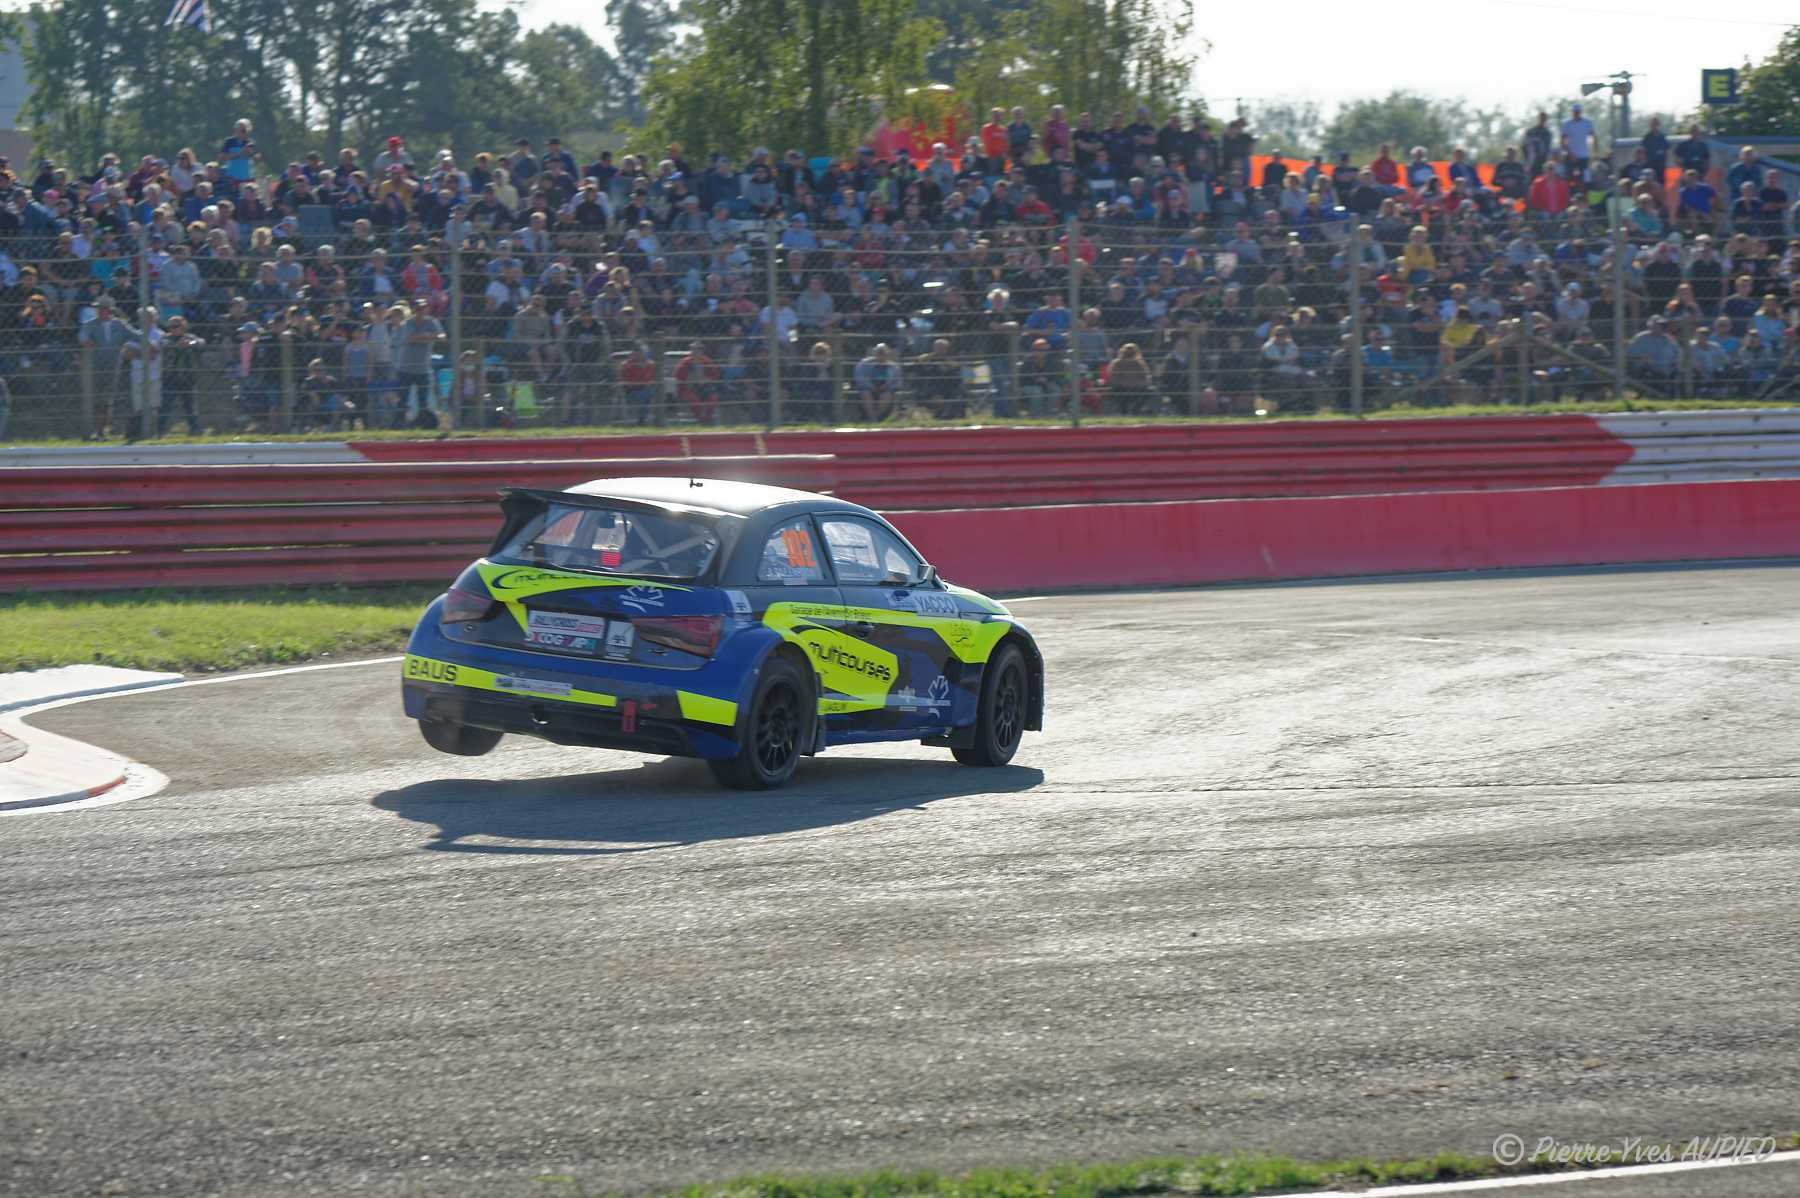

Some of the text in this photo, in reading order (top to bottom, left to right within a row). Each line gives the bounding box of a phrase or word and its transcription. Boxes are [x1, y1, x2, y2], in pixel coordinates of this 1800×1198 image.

[1709, 75, 1728, 97] E
[783, 529, 816, 567] 102
[915, 596, 957, 614] YACCO
[409, 659, 457, 682] BAUS
[808, 641, 891, 681] multicourses
